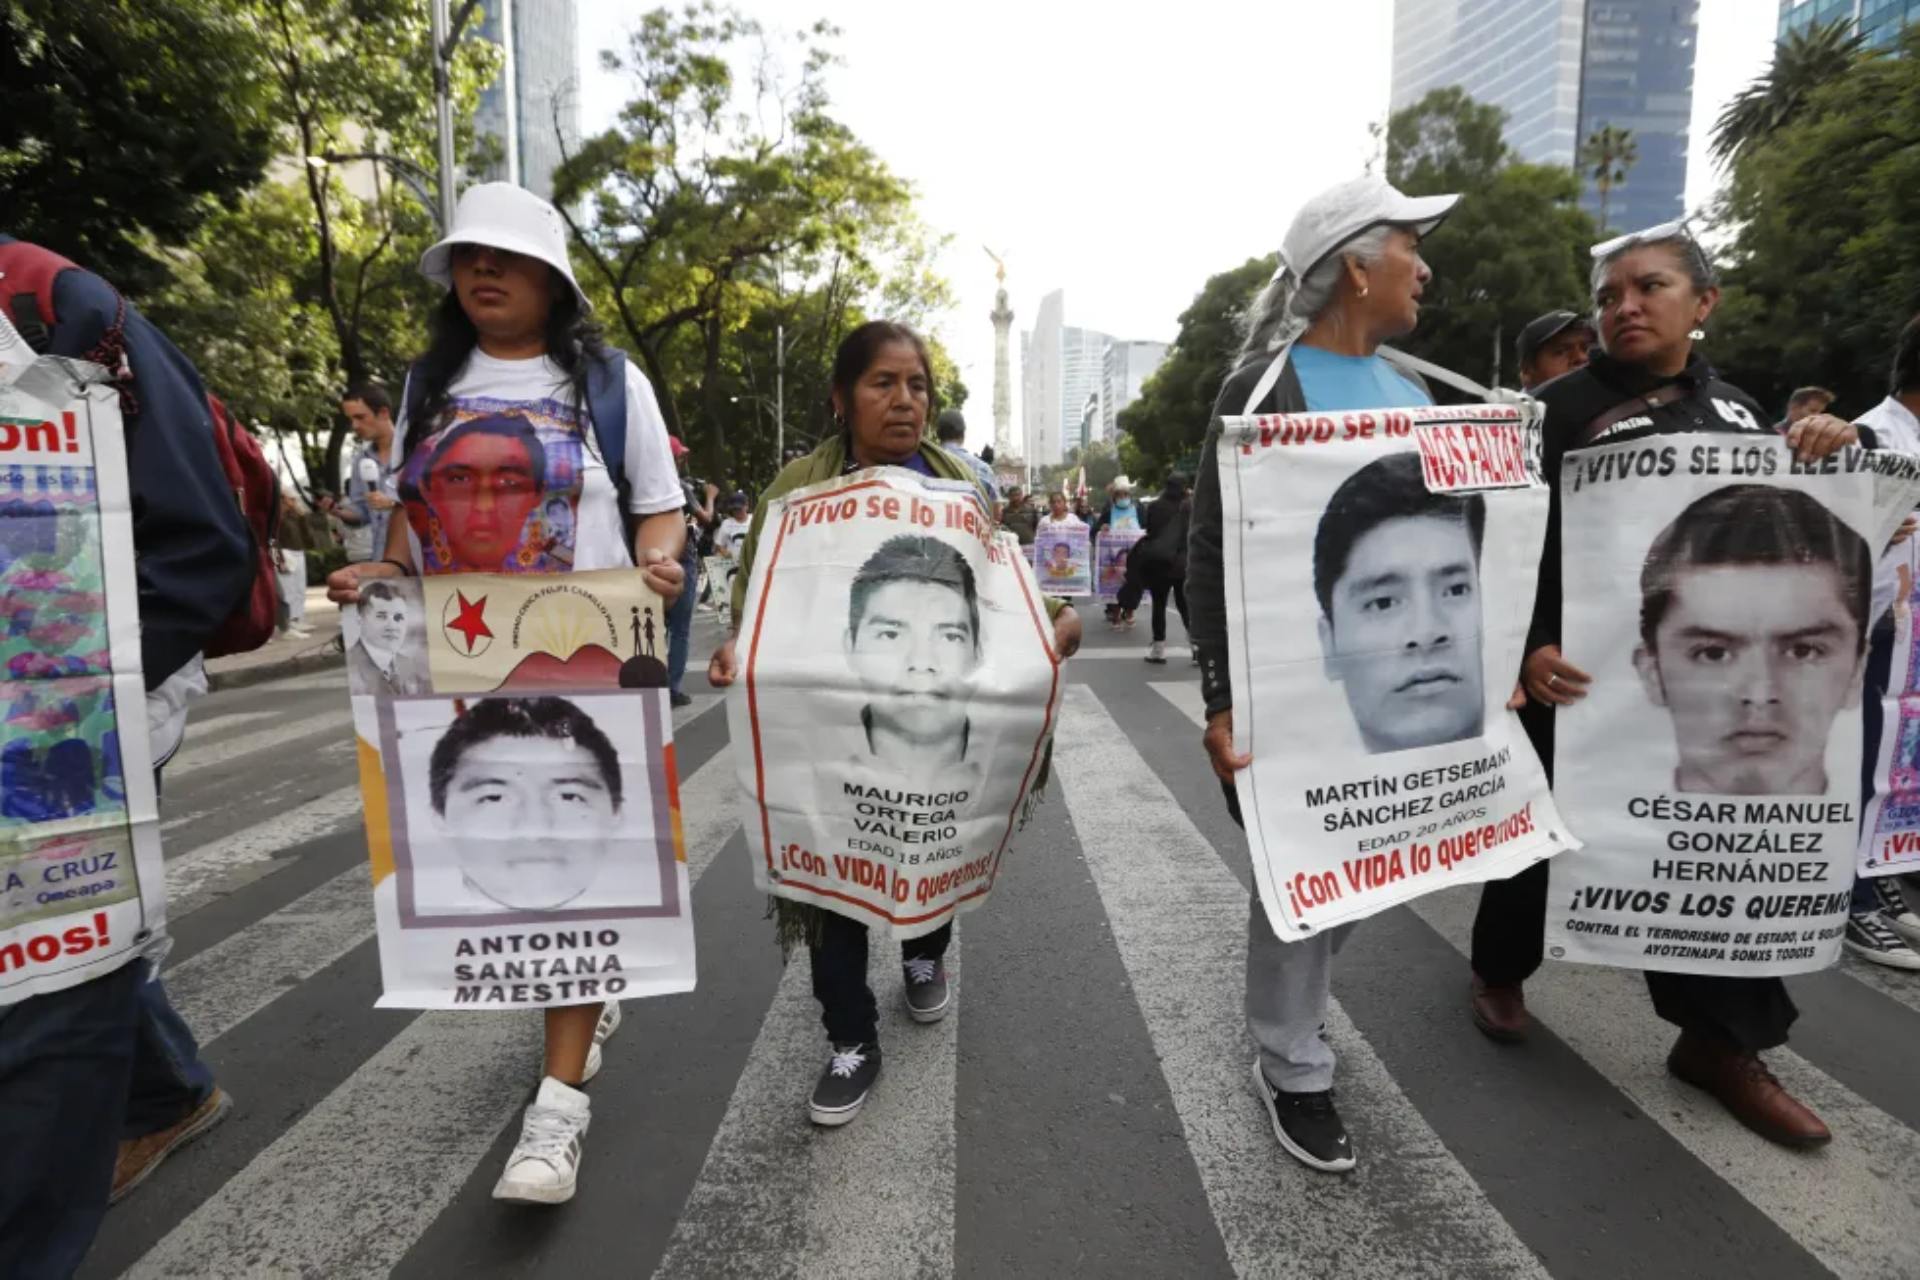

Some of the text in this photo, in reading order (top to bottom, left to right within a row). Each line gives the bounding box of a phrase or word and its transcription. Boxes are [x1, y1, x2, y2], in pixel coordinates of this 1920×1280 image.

[1342, 415, 1376, 441] se
[1384, 411, 1412, 438] lo
[1415, 426, 1469, 487] NOS
[1462, 424, 1527, 484] FALTAN
[1574, 446, 1677, 492] ¡VIVOS
[1690, 445, 1720, 475] SE
[1731, 446, 1777, 476] LOS
[788, 498, 857, 535] ¡Vivo
[866, 495, 899, 520] se
[910, 498, 935, 527] lo
[843, 782, 969, 807] MAURICIO
[1305, 774, 1397, 808] MARTÍN
[1323, 775, 1506, 832] SÁNCHEZ GARCÍA
[856, 803, 956, 826] ORTEGA
[1628, 795, 1854, 823] CÉSAR MANUEL
[854, 818, 957, 844] VALERIO
[1358, 806, 1487, 852] EDAD 20 AÑOS
[1667, 829, 1823, 853] GONZÁLEZ
[848, 838, 964, 865] EDAD 18 AÑOS
[1285, 801, 1535, 918] ¡Con VIDA lo queremos!
[43, 852, 118, 882] CRUZ
[781, 843, 994, 906] ¡Con VIDA lo queremos!
[1653, 858, 1829, 883] HERNÁNDEZ
[1570, 886, 1671, 914] ¡VIVOS
[1680, 893, 1735, 918] LOS
[455, 929, 619, 957] ANTONIO
[1566, 918, 1619, 937] CONTRA
[1625, 926, 1640, 938] EL
[1647, 927, 1730, 944] TERRORISMO
[1734, 931, 1752, 944] DE
[1755, 931, 1797, 945] ESTADO,
[1801, 930, 1815, 942] LA
[1644, 943, 1725, 960] AYOTZINAPA
[1730, 945, 1772, 962] SOMXS
[455, 954, 623, 981] SANTANA
[454, 977, 626, 1003] MAESTRO
